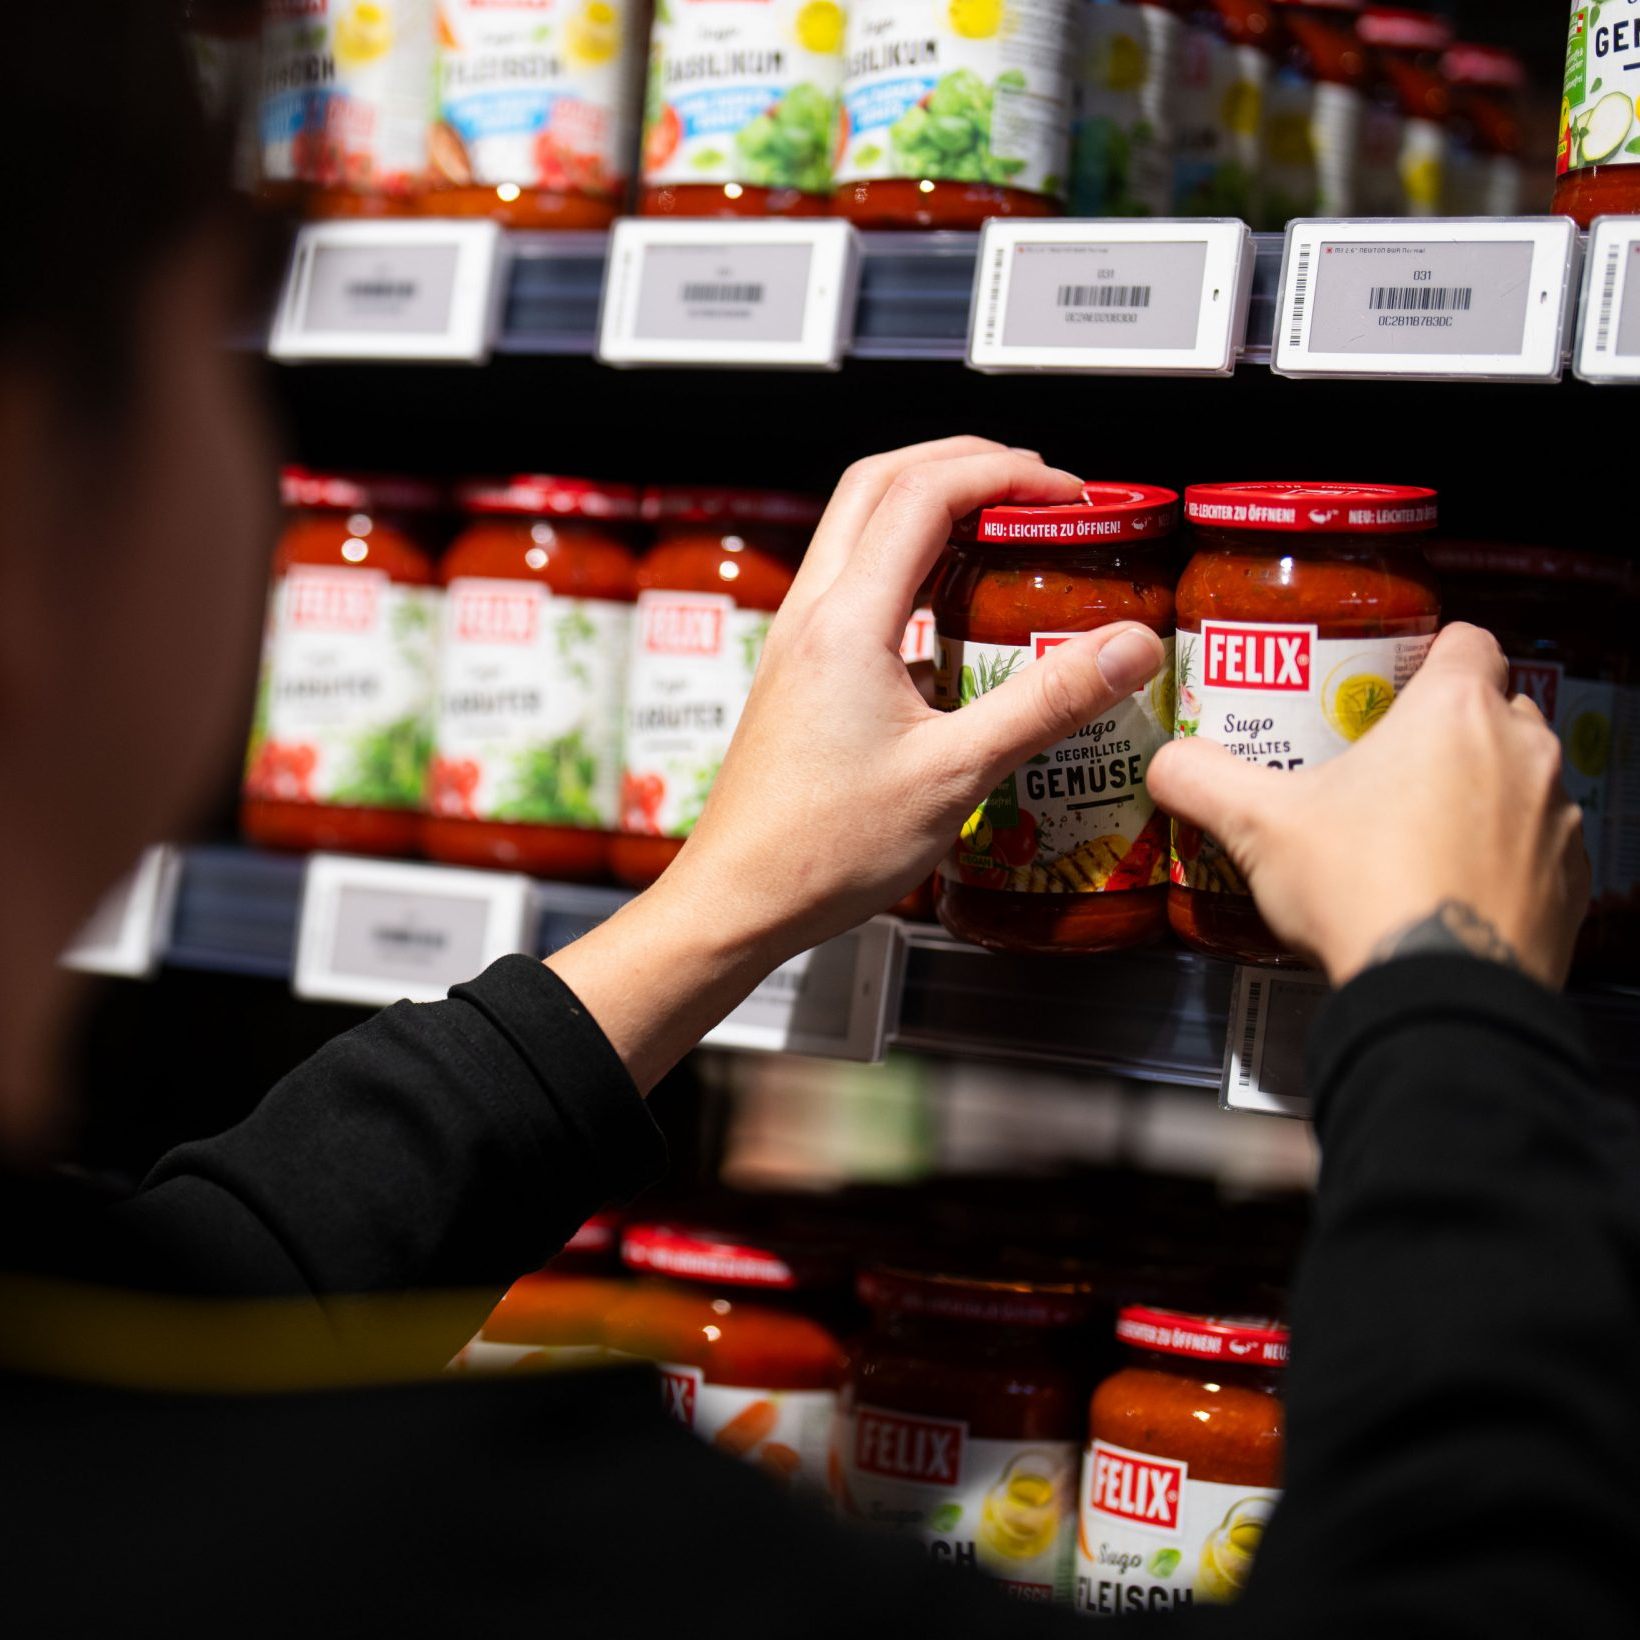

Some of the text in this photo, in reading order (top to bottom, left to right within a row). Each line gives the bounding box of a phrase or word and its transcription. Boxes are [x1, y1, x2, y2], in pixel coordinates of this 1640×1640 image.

[1413, 270, 1432, 281] 031
[1233, 506, 1247, 521] ZU
[1248, 503, 1296, 523] ÖFFNEN!
[1348, 509, 1375, 524] NEU:
[984, 520, 1121, 538] NEU: LEICHTER ZU ÖFFNEN!
[1209, 634, 1303, 686] FELIX
[1224, 713, 1274, 739] Sugo
[1055, 740, 1131, 762] GEGRILLTES
[1224, 741, 1291, 756] GRILLTES
[1026, 754, 1143, 800] GEMÜSE
[861, 1414, 953, 1480] FELIX
[1093, 1454, 1173, 1522] FELIX
[1099, 1542, 1142, 1575] Sugo
